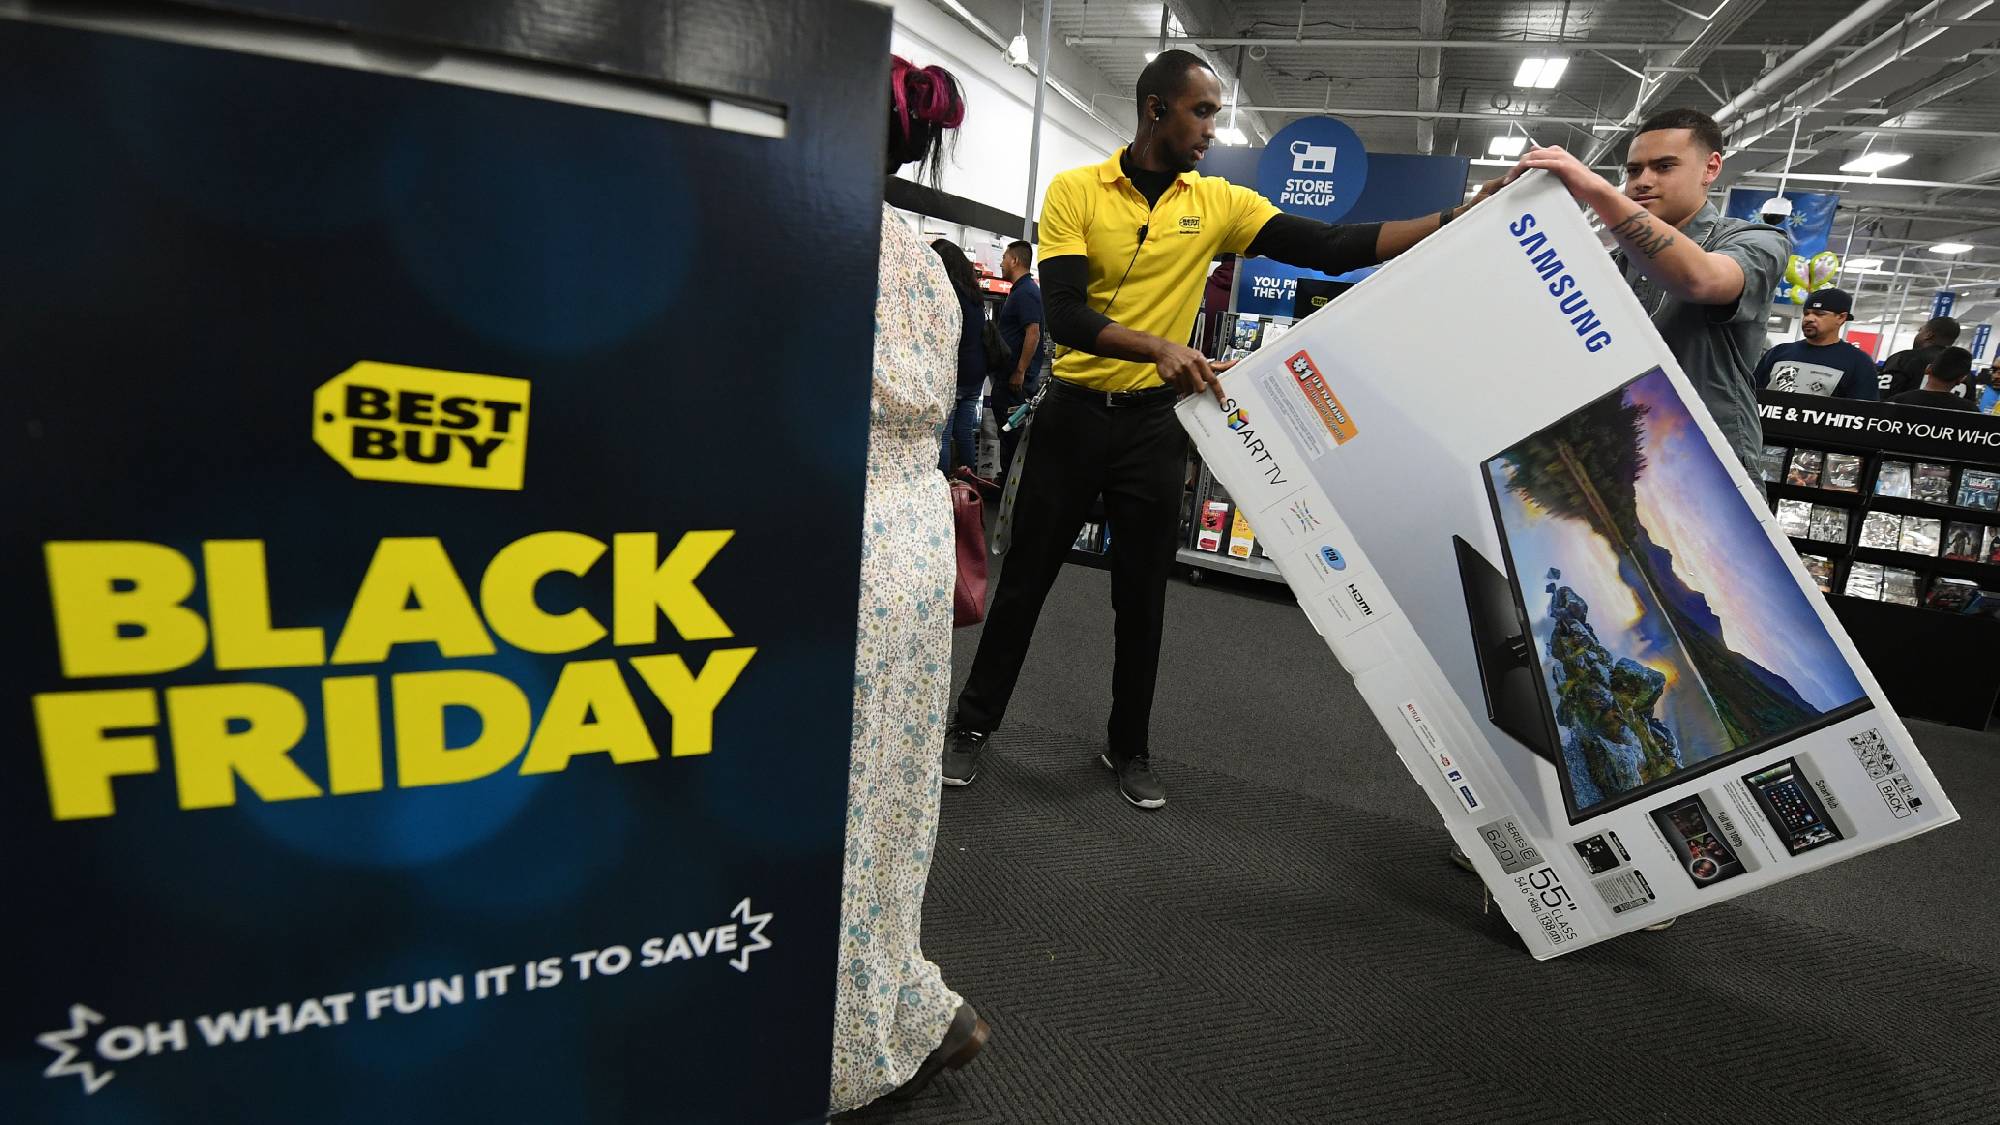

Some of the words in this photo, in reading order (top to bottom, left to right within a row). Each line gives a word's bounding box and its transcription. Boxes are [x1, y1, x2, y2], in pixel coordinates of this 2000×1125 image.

[1280, 192, 1336, 206] PICKUP
[1285, 178, 1334, 194] STORE
[1252, 286, 1286, 299] THEY
[1254, 276, 1281, 288] YOU
[1283, 279, 1298, 290] PI
[1509, 213, 1612, 353] SAMSUNG
[1291, 356, 1314, 381] #1
[344, 384, 523, 435] BEST
[1326, 398, 1346, 424] BRAND
[1784, 407, 1799, 422] &
[1801, 409, 1826, 425] TV
[1824, 412, 1865, 430] HITS
[1866, 417, 1903, 434] FOR
[1906, 422, 1954, 441] YOUR
[351, 425, 506, 469] BUY
[1322, 548, 1339, 563] 120
[44, 530, 737, 679] BLACK
[1347, 583, 1374, 617] HDMI
[1405, 702, 1423, 724] NETFLIX
[33, 646, 759, 821] FRIDAY
[1882, 784, 1905, 814] BACK
[1486, 829, 1518, 867] 6201
[1504, 821, 1528, 849] SERIES
[1551, 908, 1578, 940] CLASS
[98, 1018, 188, 1061] OH
[197, 993, 355, 1048] WHAT
[365, 974, 465, 1020] FUN
[476, 964, 515, 1000] IT
[526, 957, 563, 990] IS
[572, 945, 631, 981] TO
[640, 924, 739, 967] SAVE
